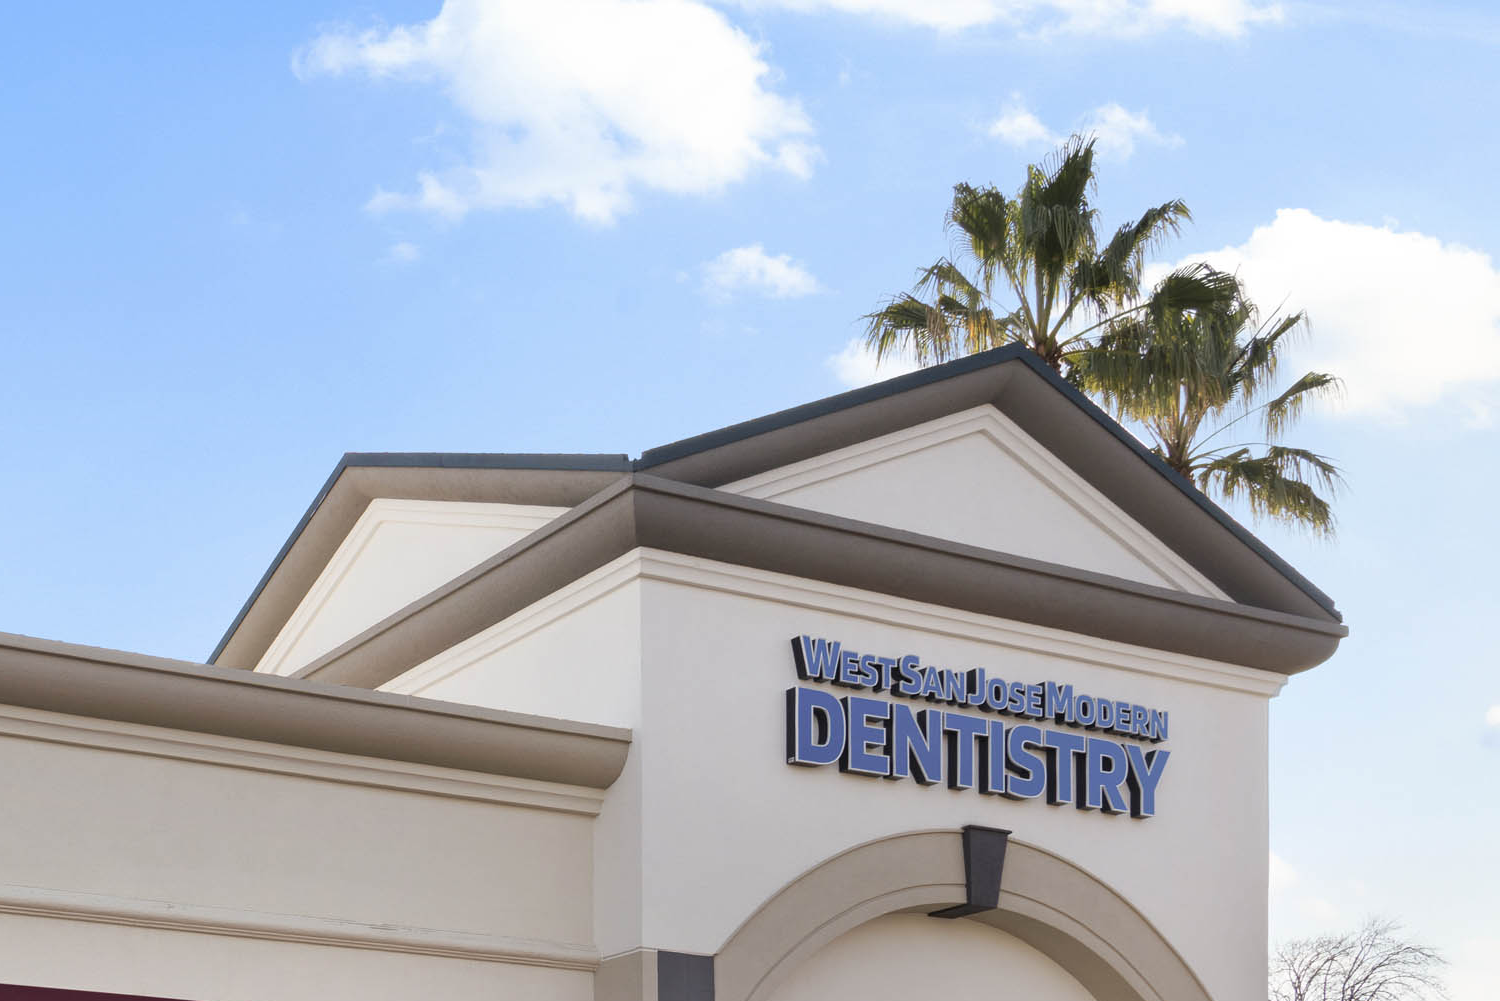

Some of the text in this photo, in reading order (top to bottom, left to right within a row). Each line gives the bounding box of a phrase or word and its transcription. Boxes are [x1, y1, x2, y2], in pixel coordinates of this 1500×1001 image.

[796, 634, 1170, 740] WEST SAN JOSE MODERN
[791, 686, 1171, 818] DENTISTRY
